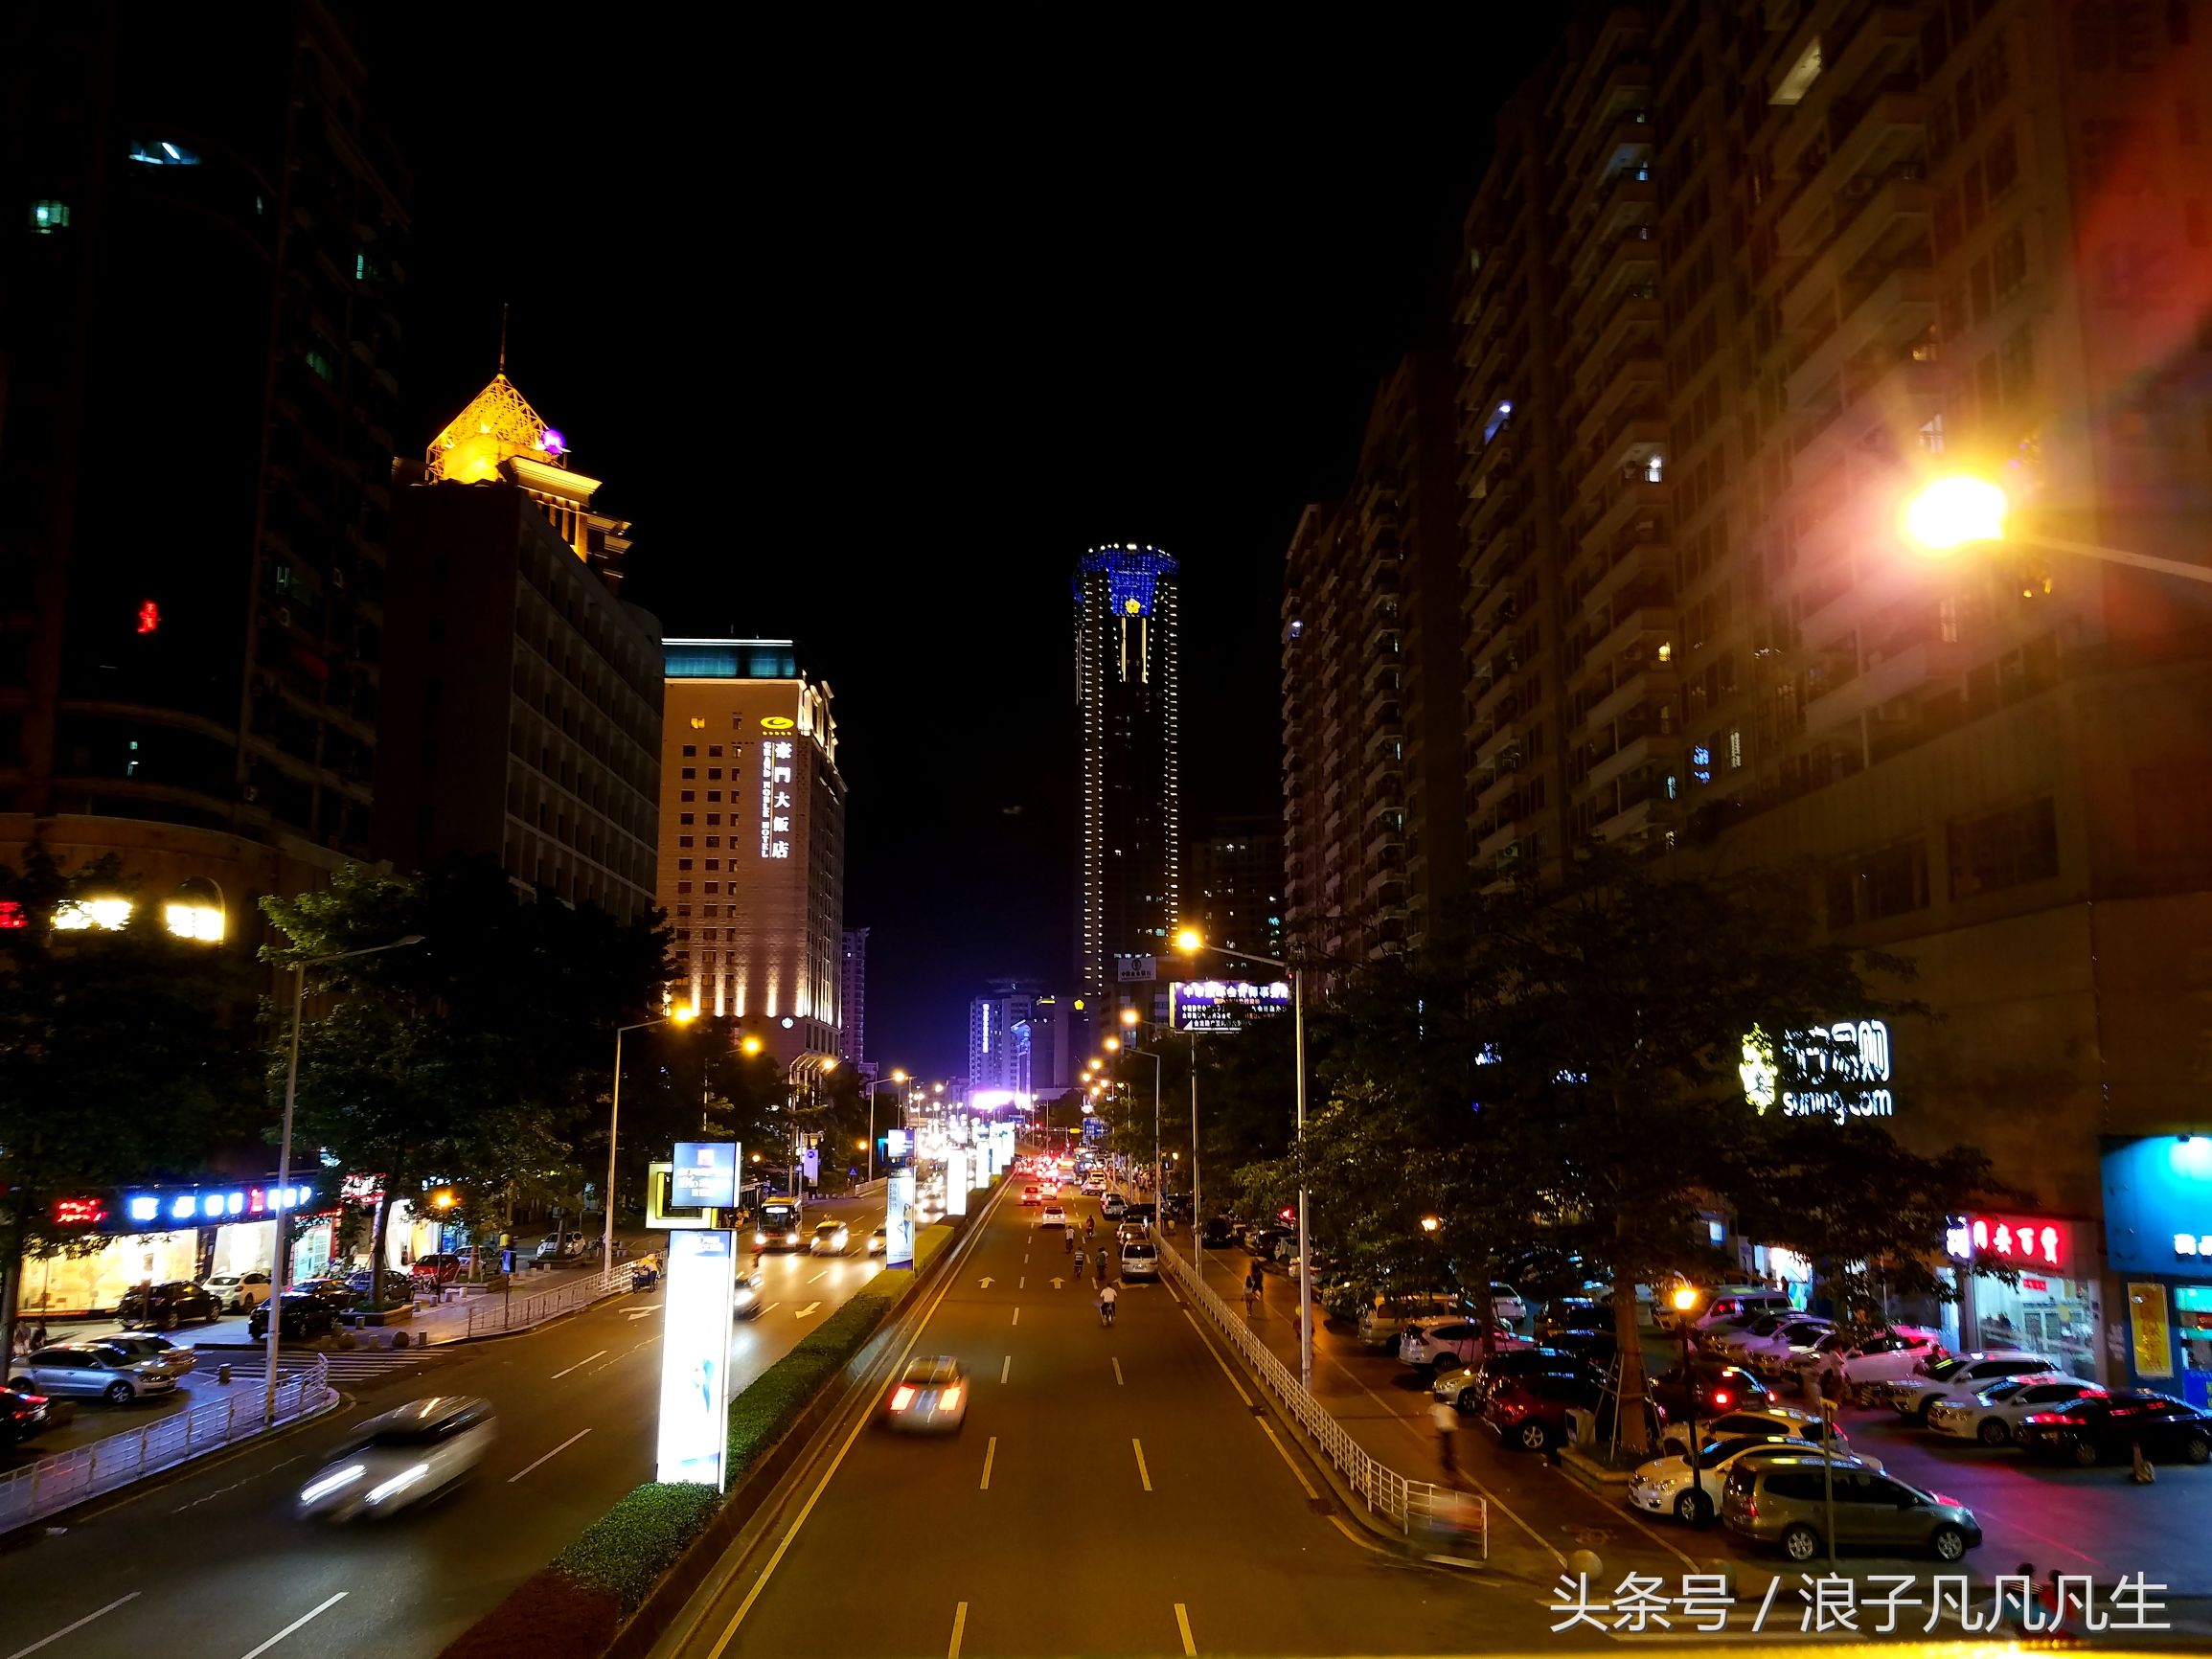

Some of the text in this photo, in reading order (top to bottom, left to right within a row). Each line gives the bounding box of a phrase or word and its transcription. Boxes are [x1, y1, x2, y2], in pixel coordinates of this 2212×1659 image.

[772, 741, 792, 858] 豪門大飯店
[1782, 1089, 1893, 1126] suningcom
